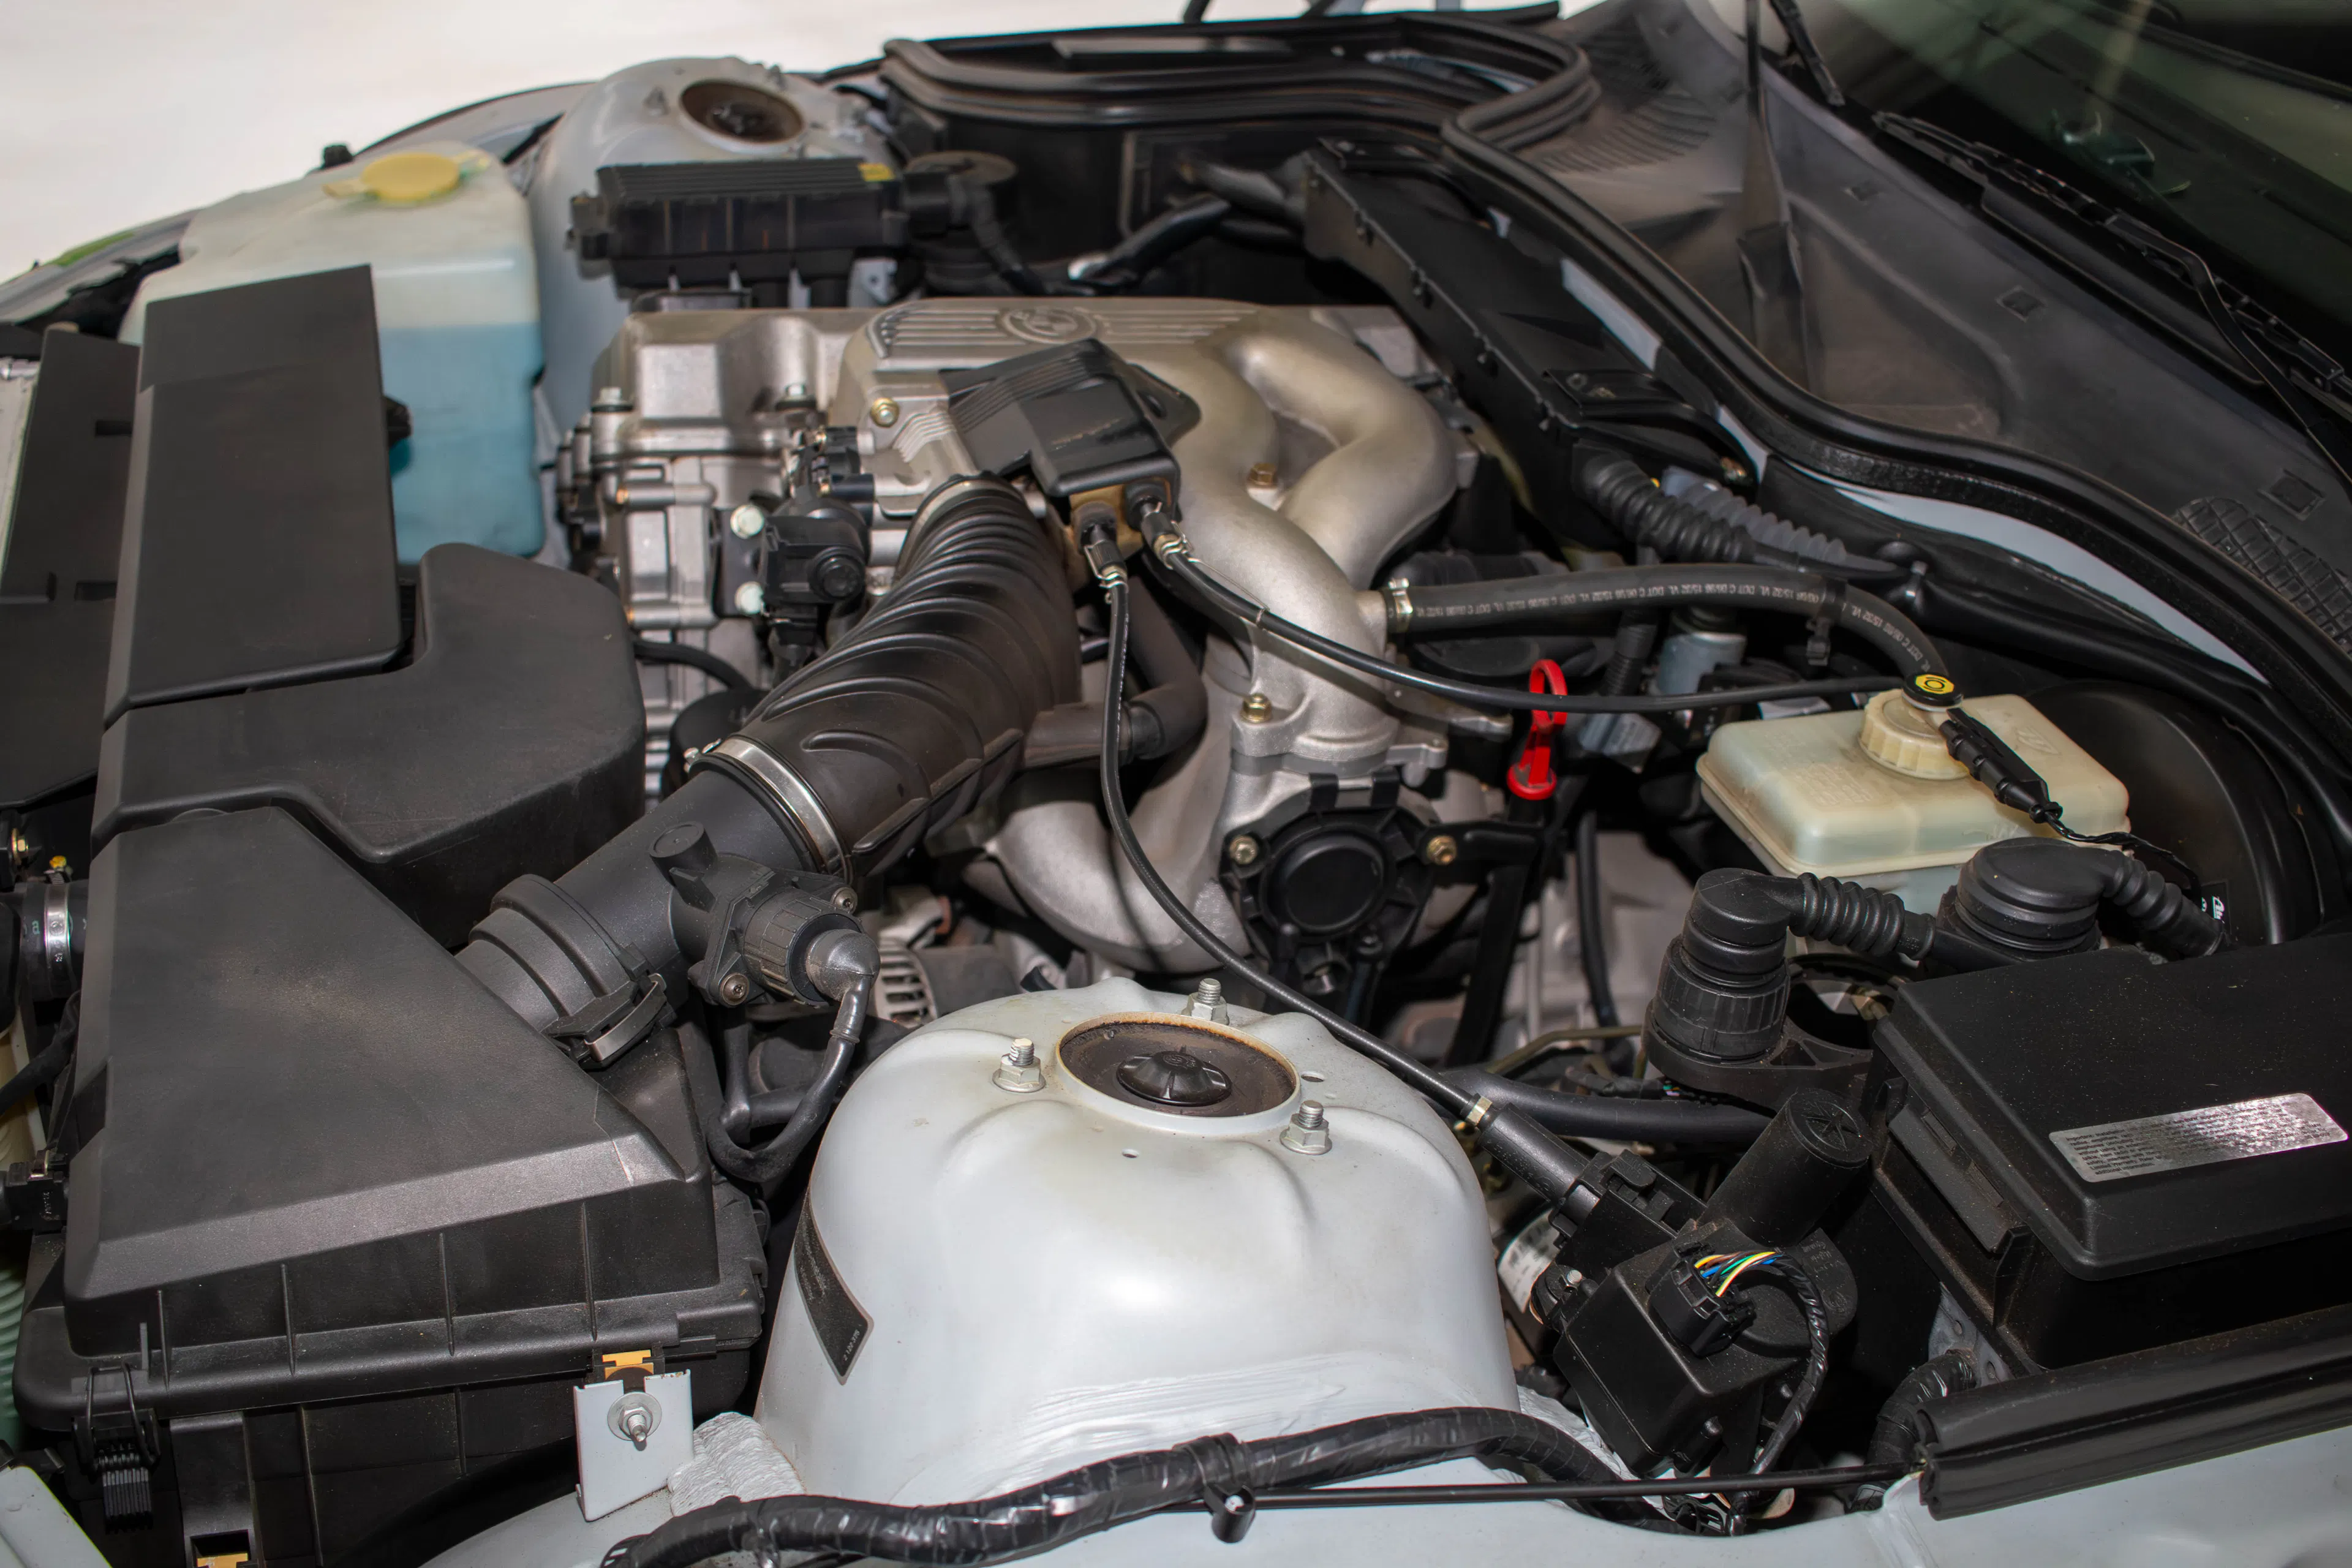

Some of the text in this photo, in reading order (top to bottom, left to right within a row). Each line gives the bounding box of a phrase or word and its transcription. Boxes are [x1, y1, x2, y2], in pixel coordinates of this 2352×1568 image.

[1638, 586, 1645, 597] C
[1646, 585, 1664, 596] DOT
[1728, 583, 1735, 594] C
[1737, 584, 1755, 595] DOT
